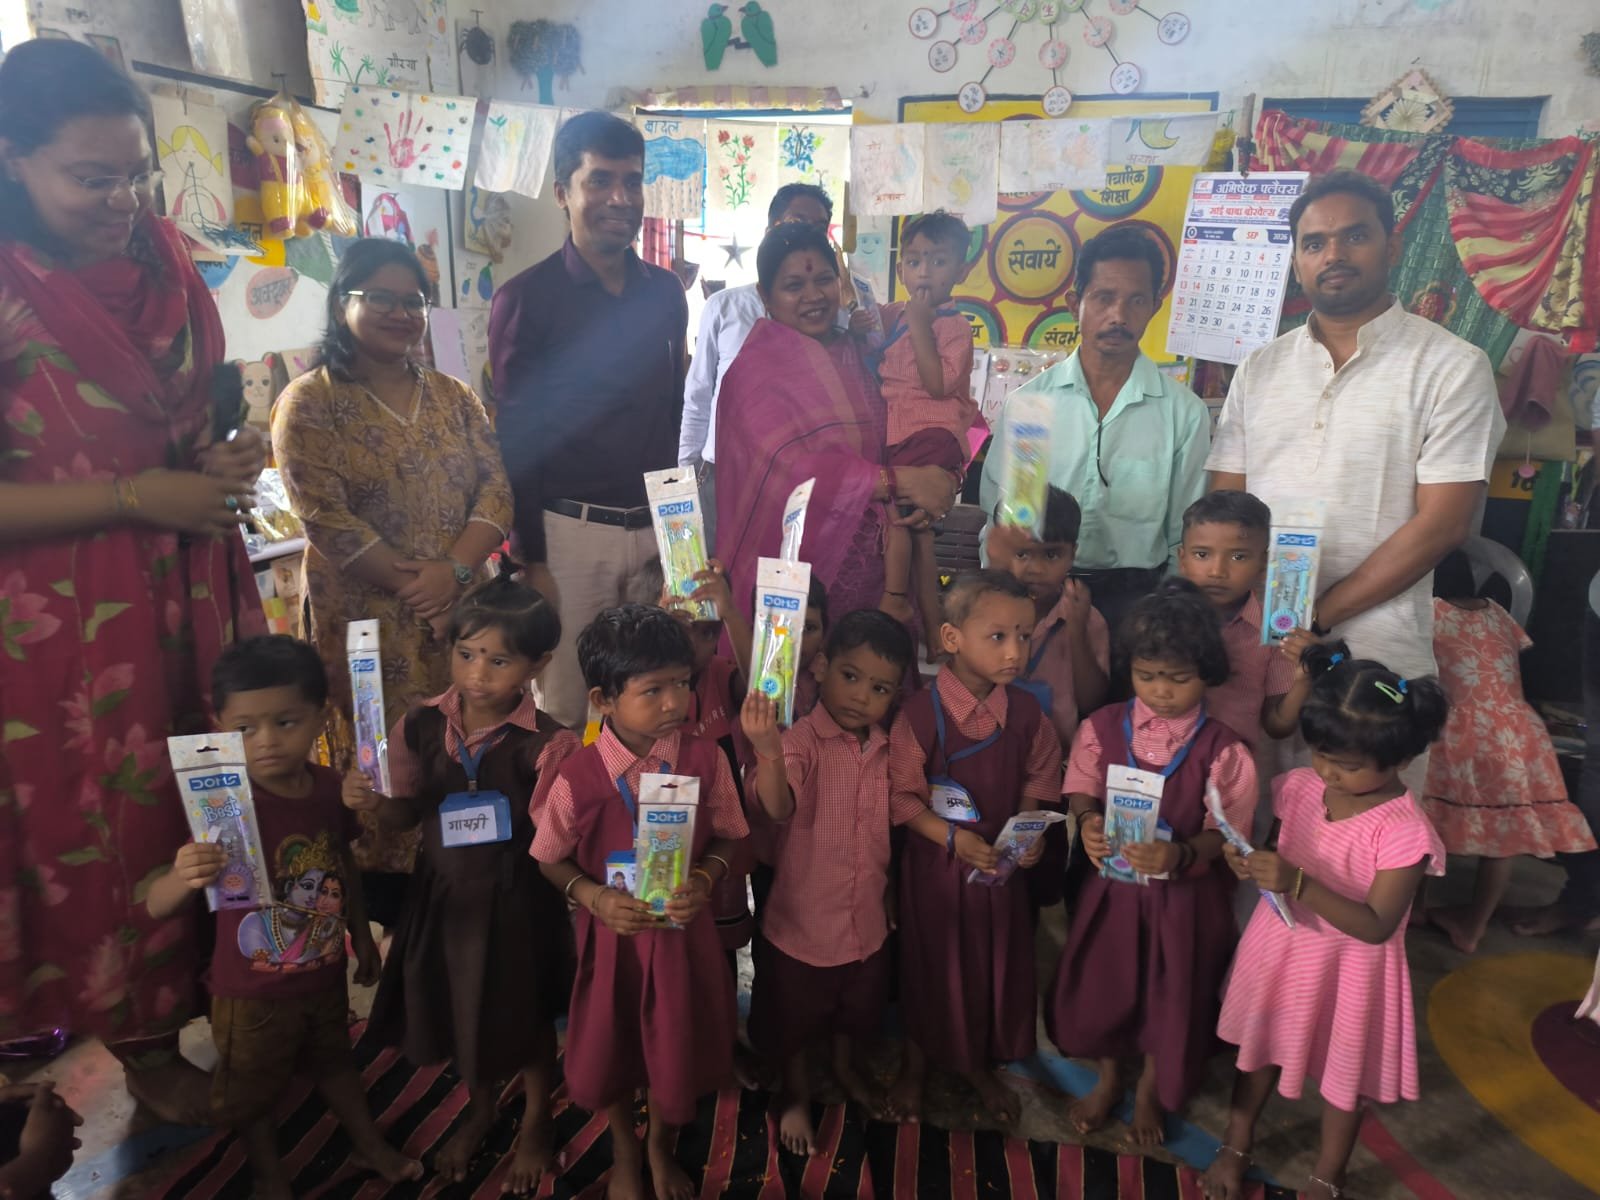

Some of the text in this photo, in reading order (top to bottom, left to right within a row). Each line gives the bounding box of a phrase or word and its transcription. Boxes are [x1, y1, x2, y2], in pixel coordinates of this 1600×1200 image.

[644, 119, 682, 136] बादल
[1215, 181, 1258, 195] अभिषेक
[1246, 231, 1288, 241] SEP 2026
[1008, 239, 1062, 275] सेवायें
[1240, 269, 1249, 278] 10
[1255, 270, 1263, 279] 11
[1271, 271, 1279, 280] 12
[1180, 281, 1275, 297] 13 14 15 16 17 18 19
[1177, 297, 1271, 315] 20 21 22 23 24 25 26
[1175, 313, 1222, 327] 27 28 29 30
[660, 501, 693, 516] DOMS
[1278, 535, 1315, 546] DOMS
[765, 595, 799, 610] DOMS
[191, 775, 239, 790] DOMS
[203, 797, 241, 822] Best
[1115, 796, 1152, 809] DOMS
[448, 813, 490, 831] गायत्री
[648, 813, 687, 823] DOMS
[1015, 822, 1044, 831] DOMS
[651, 832, 681, 851] Best
